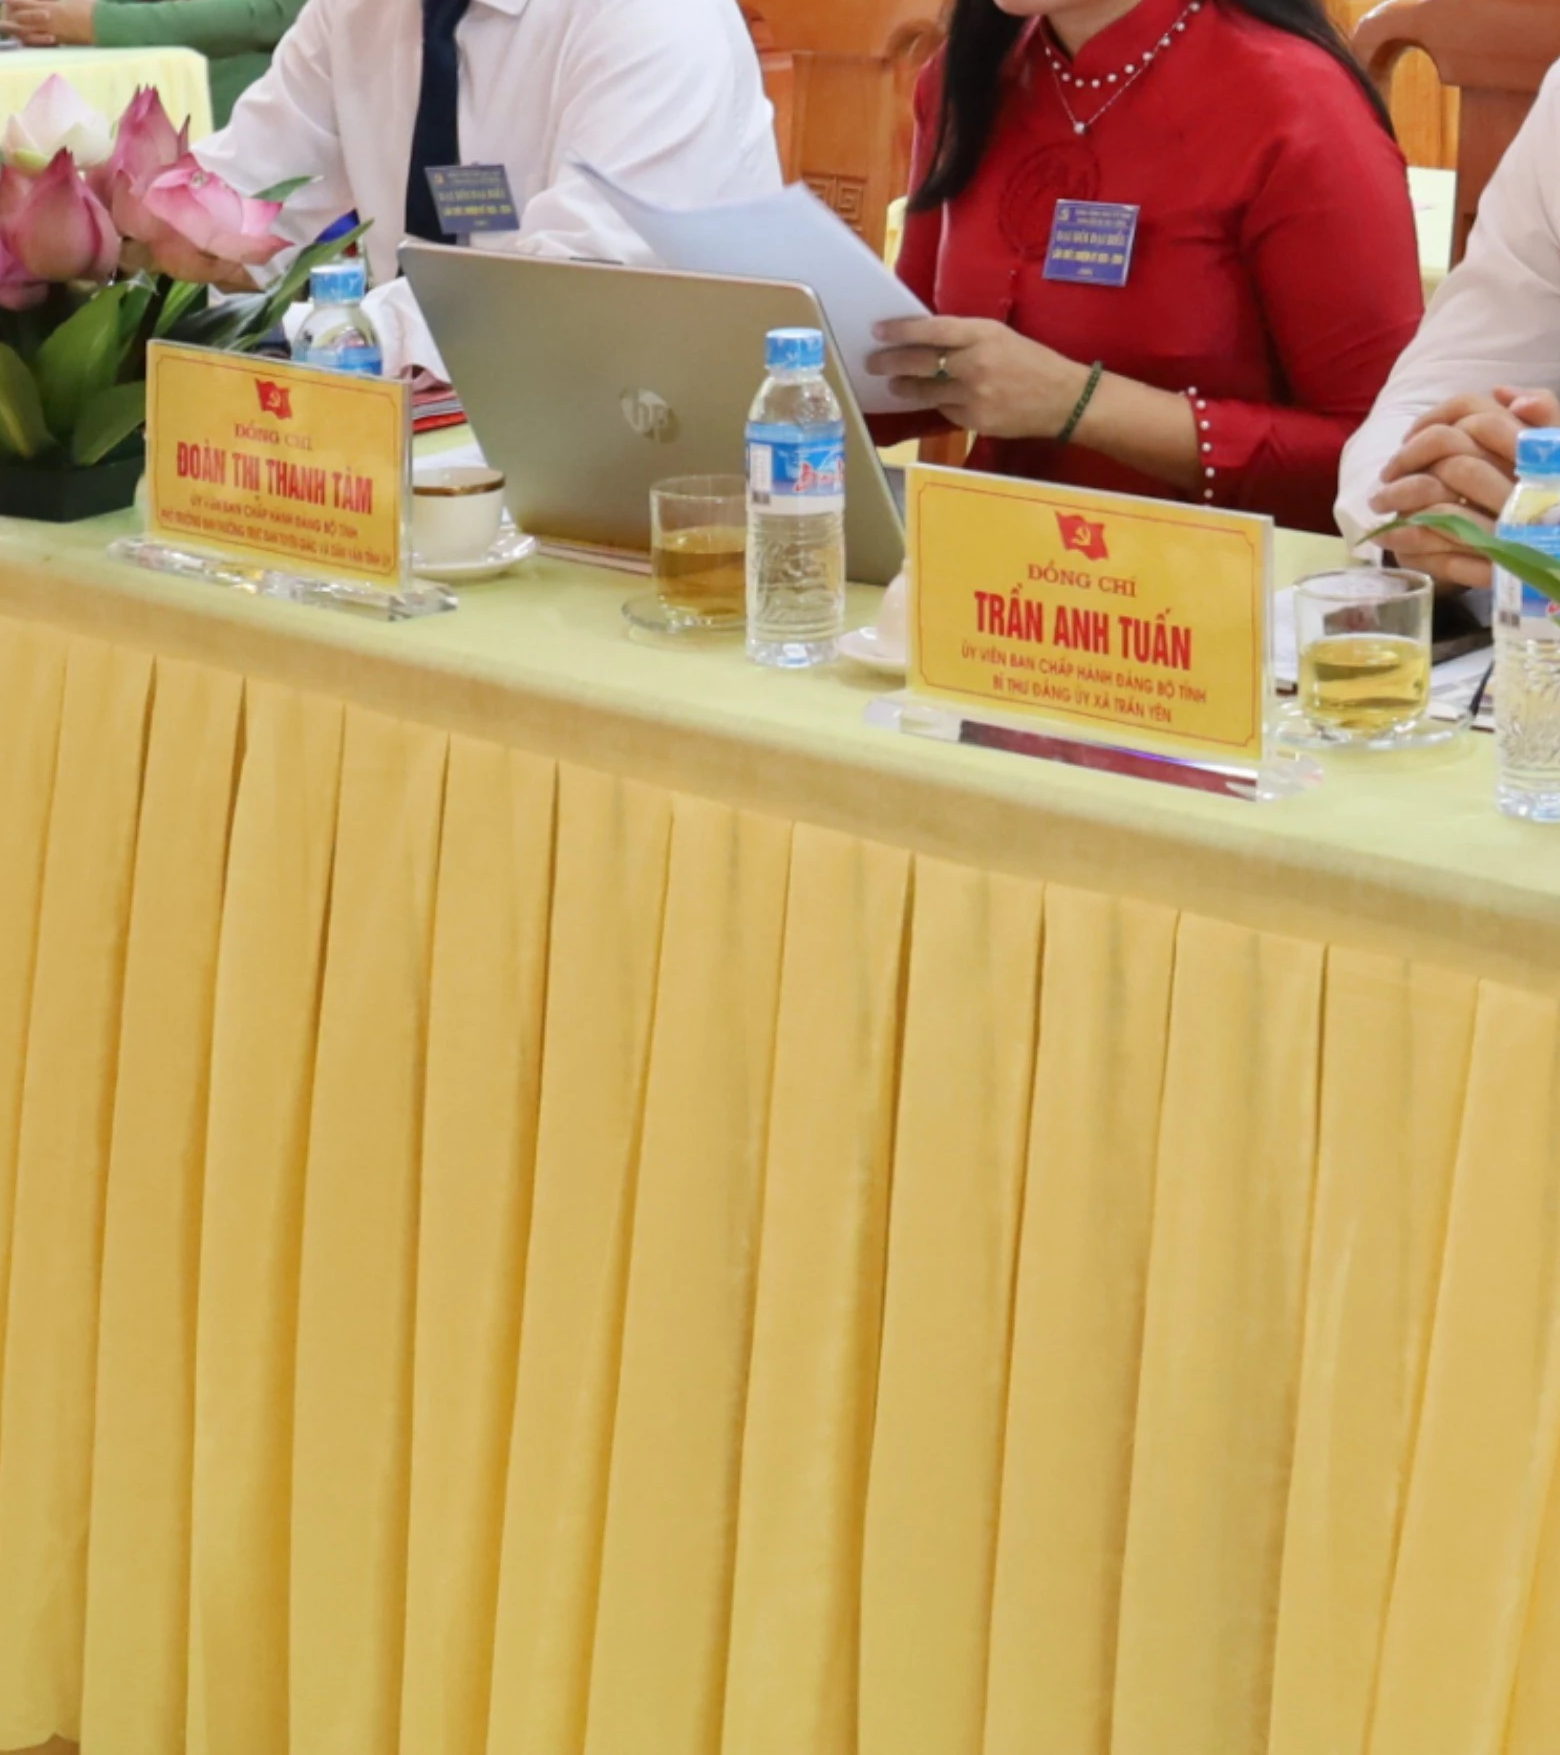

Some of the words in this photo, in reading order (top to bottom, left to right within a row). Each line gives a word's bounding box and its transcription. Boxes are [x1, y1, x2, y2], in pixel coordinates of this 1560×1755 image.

[234, 420, 280, 445] ĐỒNG
[624, 388, 677, 443] hp
[176, 439, 226, 486] ĐOÀN
[232, 452, 261, 501] THỊ
[266, 458, 326, 506] THANH
[1027, 559, 1091, 589] ĐỒNG
[1098, 573, 1137, 598] CHÍ
[974, 582, 1044, 644] TRẦN
[1053, 604, 1110, 655] ANH
[1118, 608, 1192, 671] TUẤN
[961, 639, 977, 660] ỦY
[980, 646, 1007, 668] VIÊN
[1010, 652, 1036, 671] BAN
[1040, 654, 1074, 677] CHẤP
[1077, 663, 1113, 683] HÀNH
[1115, 669, 1153, 694] ĐẢNG
[1156, 677, 1175, 701] BỘ
[1178, 682, 1207, 704] TỈNH
[1007, 677, 1029, 696] THƯ
[1032, 679, 1072, 703] ĐẢNG
[1074, 685, 1090, 706] ỦY
[1092, 690, 1110, 709] XÃ
[1113, 695, 1145, 717] TRẤN
[1147, 701, 1173, 723] YÊN
